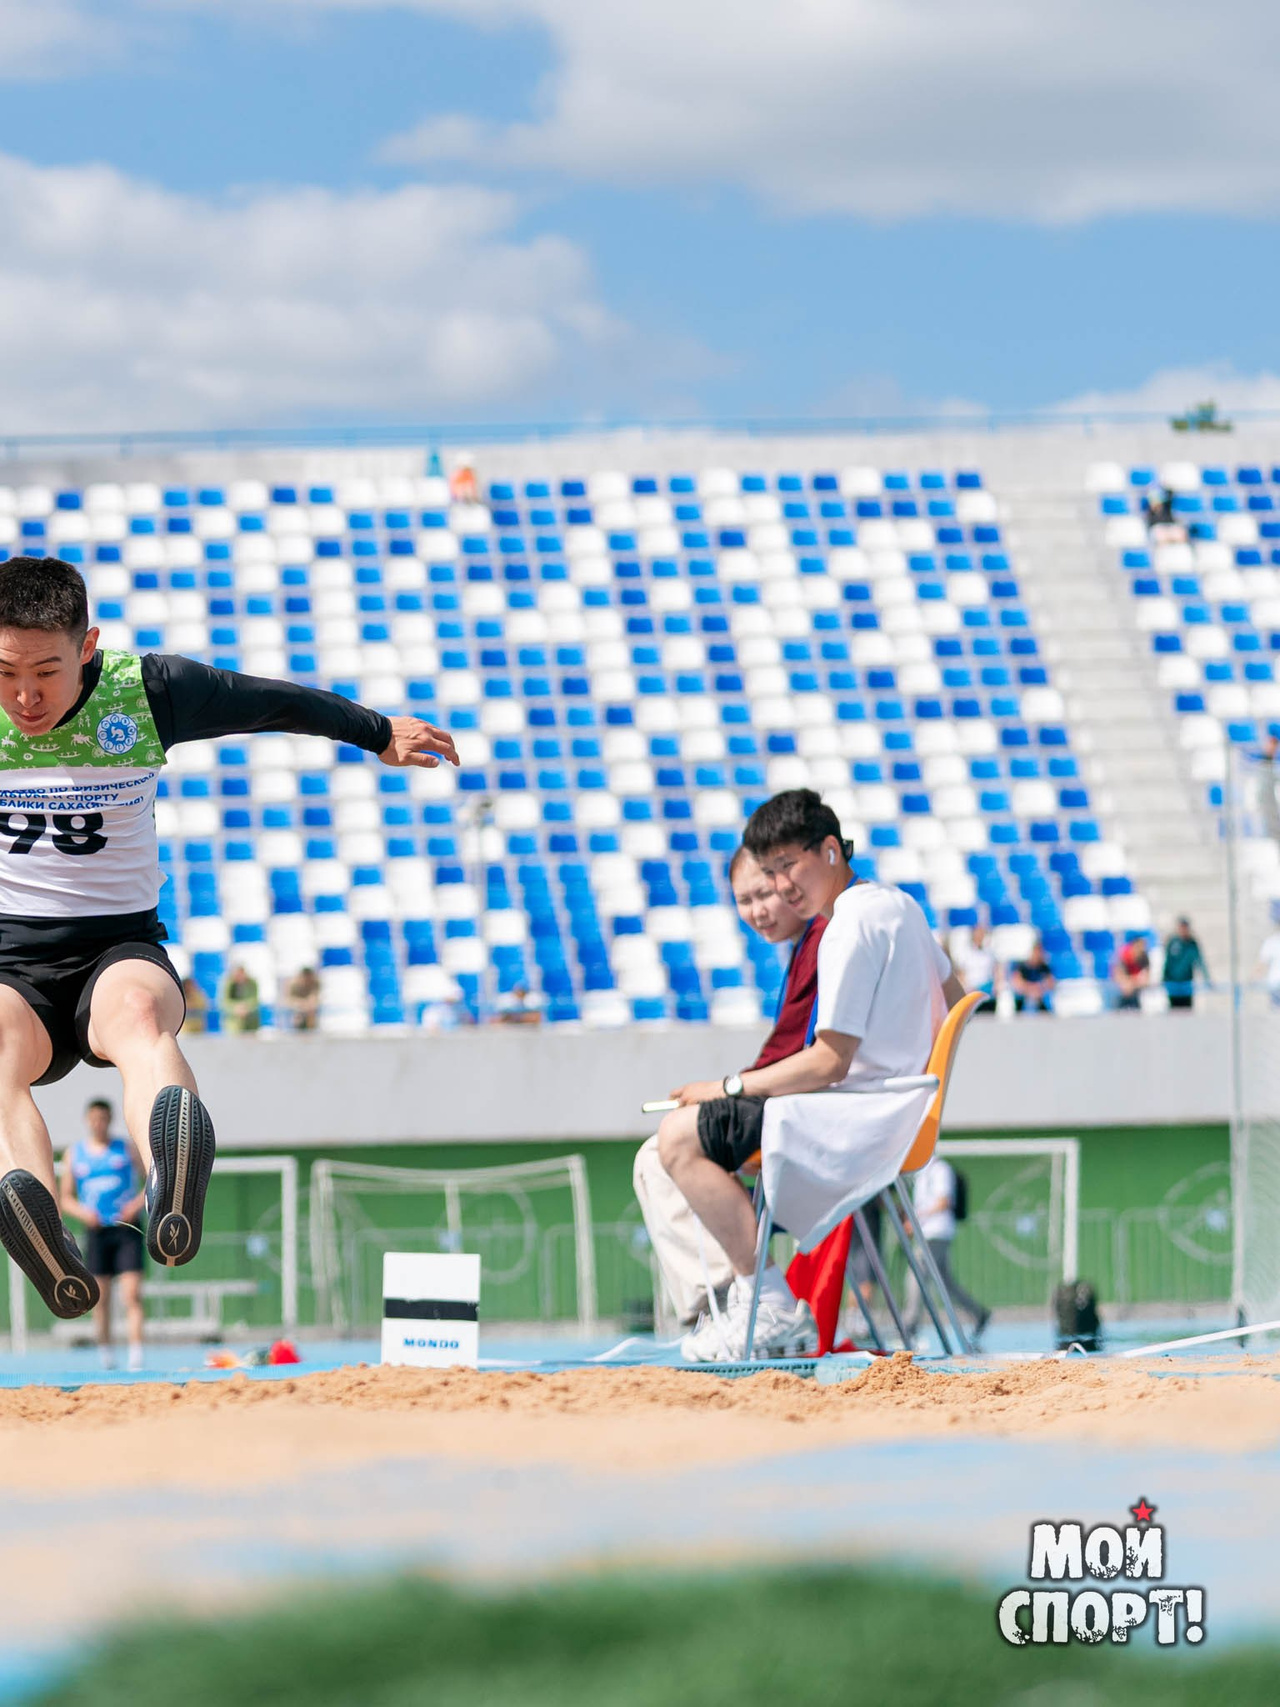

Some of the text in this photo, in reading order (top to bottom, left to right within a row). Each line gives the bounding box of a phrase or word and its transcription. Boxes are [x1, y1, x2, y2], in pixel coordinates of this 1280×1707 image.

[66, 793, 119, 802] СПОРТУ
[48, 796, 144, 811] САХА(ЯИЯ)
[403, 1338, 460, 1349] MONDO
